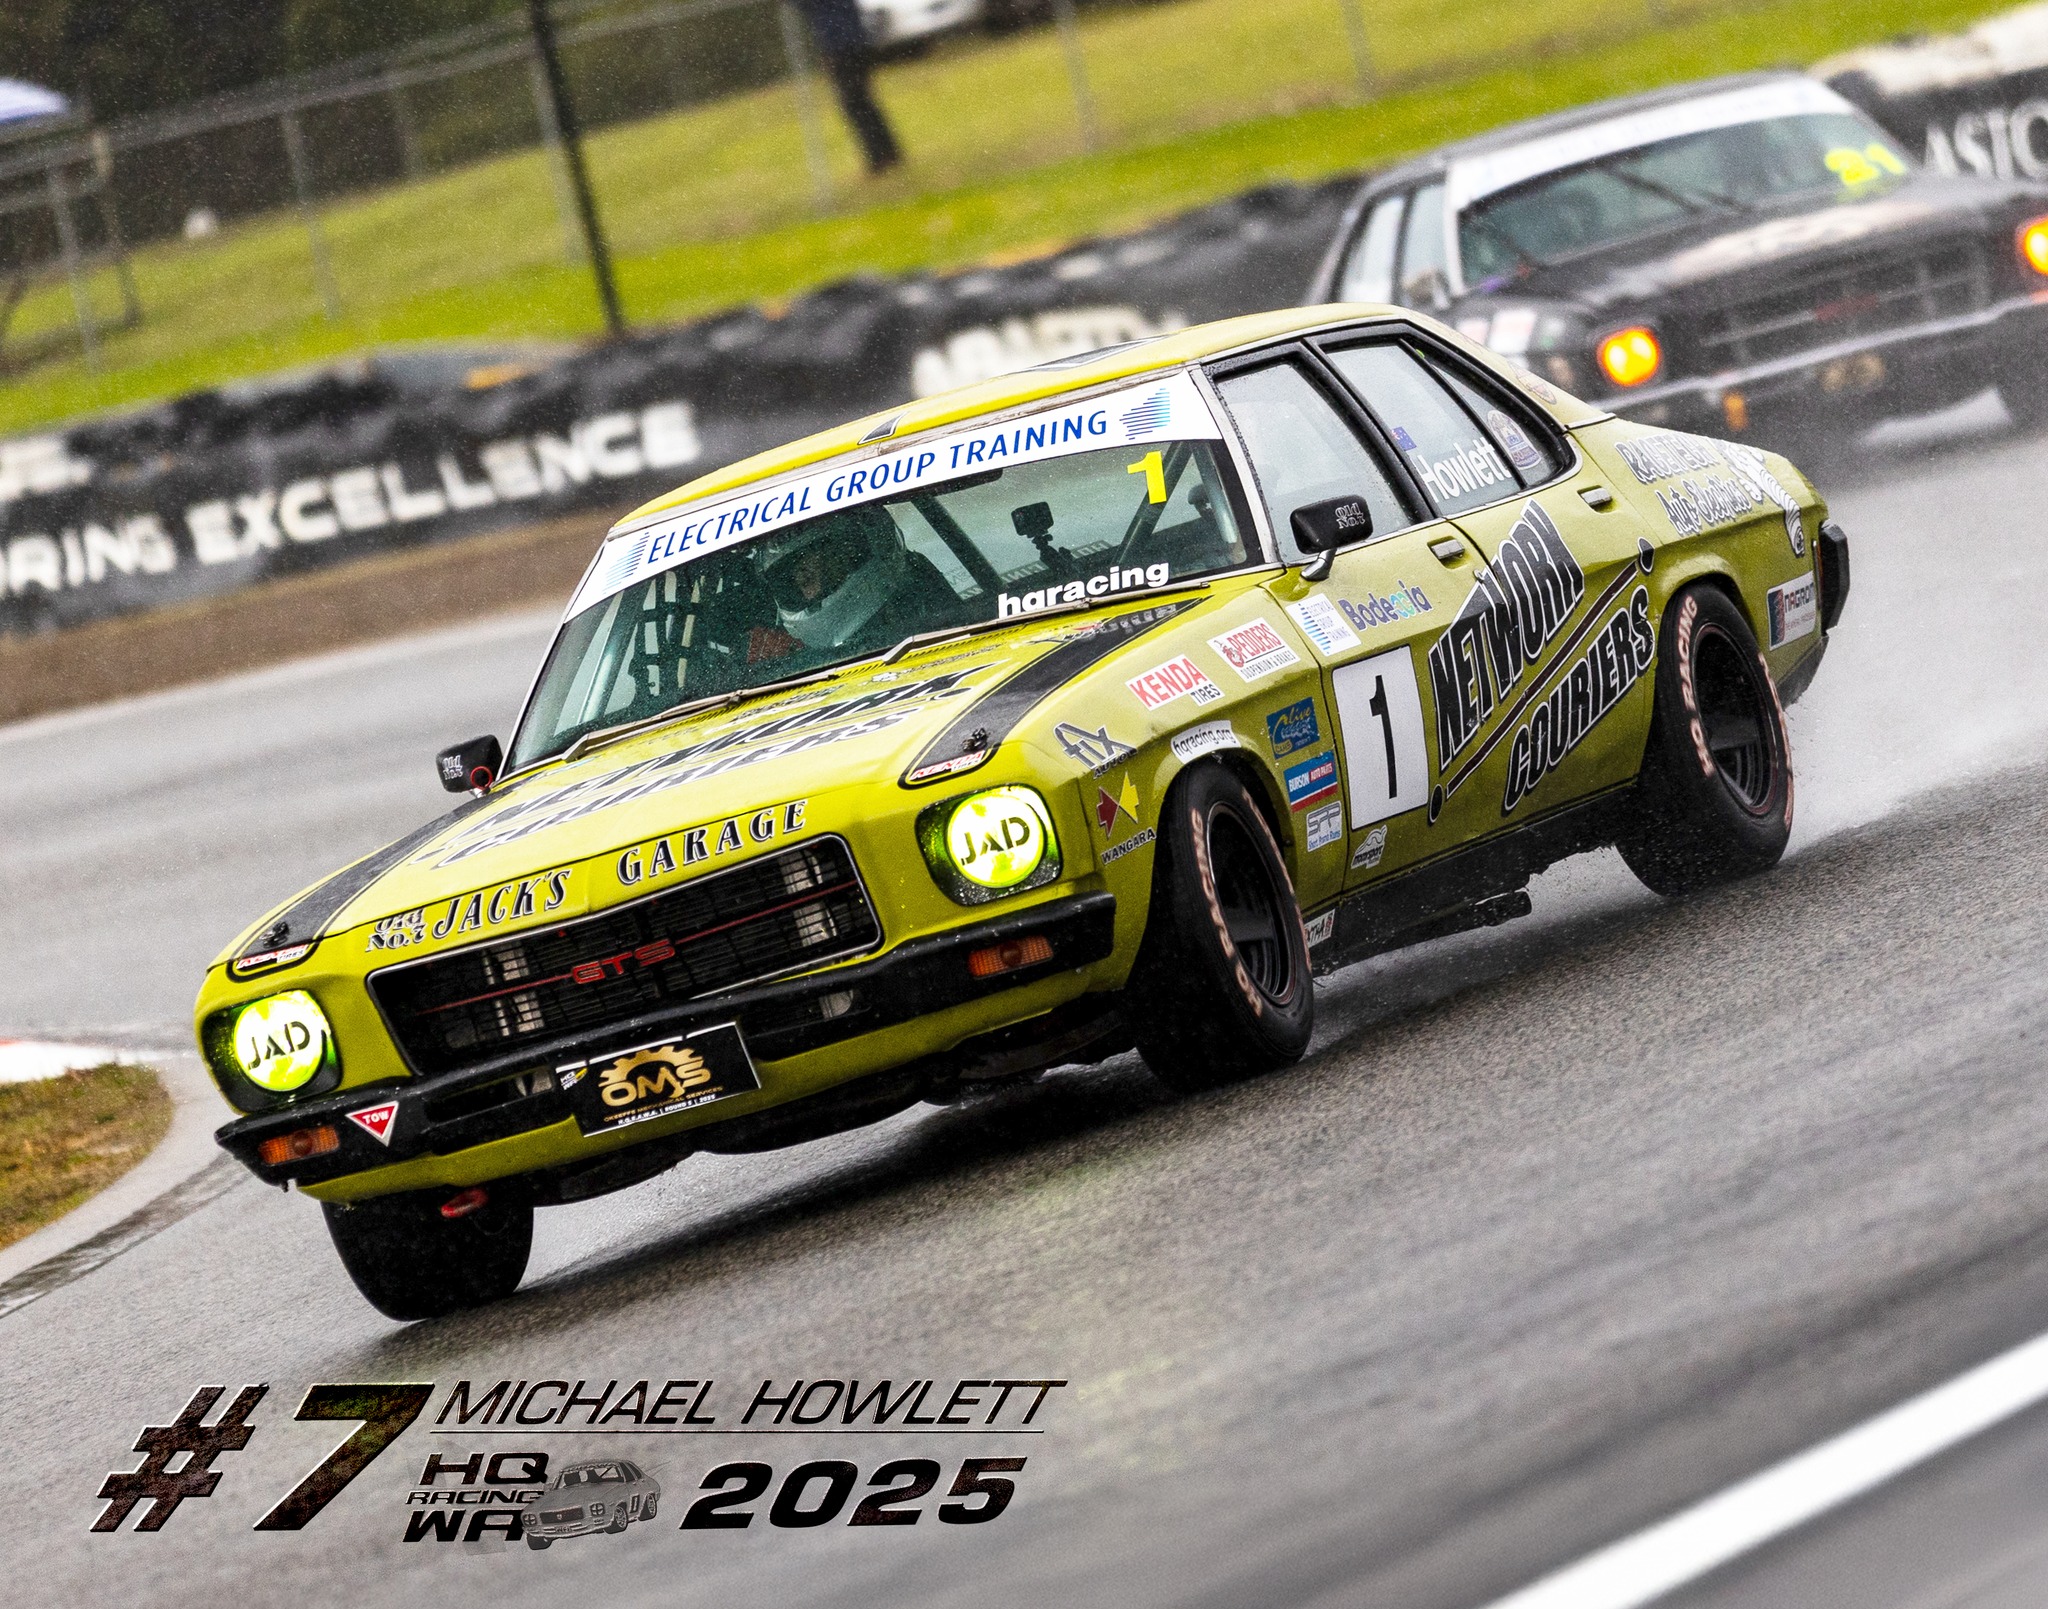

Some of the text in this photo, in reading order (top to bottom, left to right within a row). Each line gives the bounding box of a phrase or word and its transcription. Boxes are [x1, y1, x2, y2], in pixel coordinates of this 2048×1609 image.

[647, 409, 1108, 565] ELECTRICAL GROUP TRAINING
[1126, 450, 1168, 504] 1
[1410, 437, 1512, 503] Howlett
[0, 512, 177, 600] RING
[184, 400, 701, 566] EXCELLENCE
[1226, 622, 1282, 660] PEDDERS
[1428, 498, 1585, 771] NETWORK
[1677, 594, 1698, 713] RACING
[1129, 658, 1208, 707] KENDA
[1190, 684, 1221, 704] TIRES
[1504, 583, 1656, 811] COURIERS
[1172, 728, 1237, 757] hqracing.org
[1369, 674, 1397, 799] 1
[1288, 772, 1310, 793] BURSON
[961, 816, 1030, 867] JAD
[1101, 827, 1157, 865] WANGARA
[431, 799, 808, 940] JACK'S GARAGE
[571, 938, 675, 985] GTS
[247, 1020, 311, 1071] JAD
[600, 1056, 712, 1107] OMS
[685, 1086, 723, 1100] SERVICES
[361, 1109, 389, 1125] TOW
